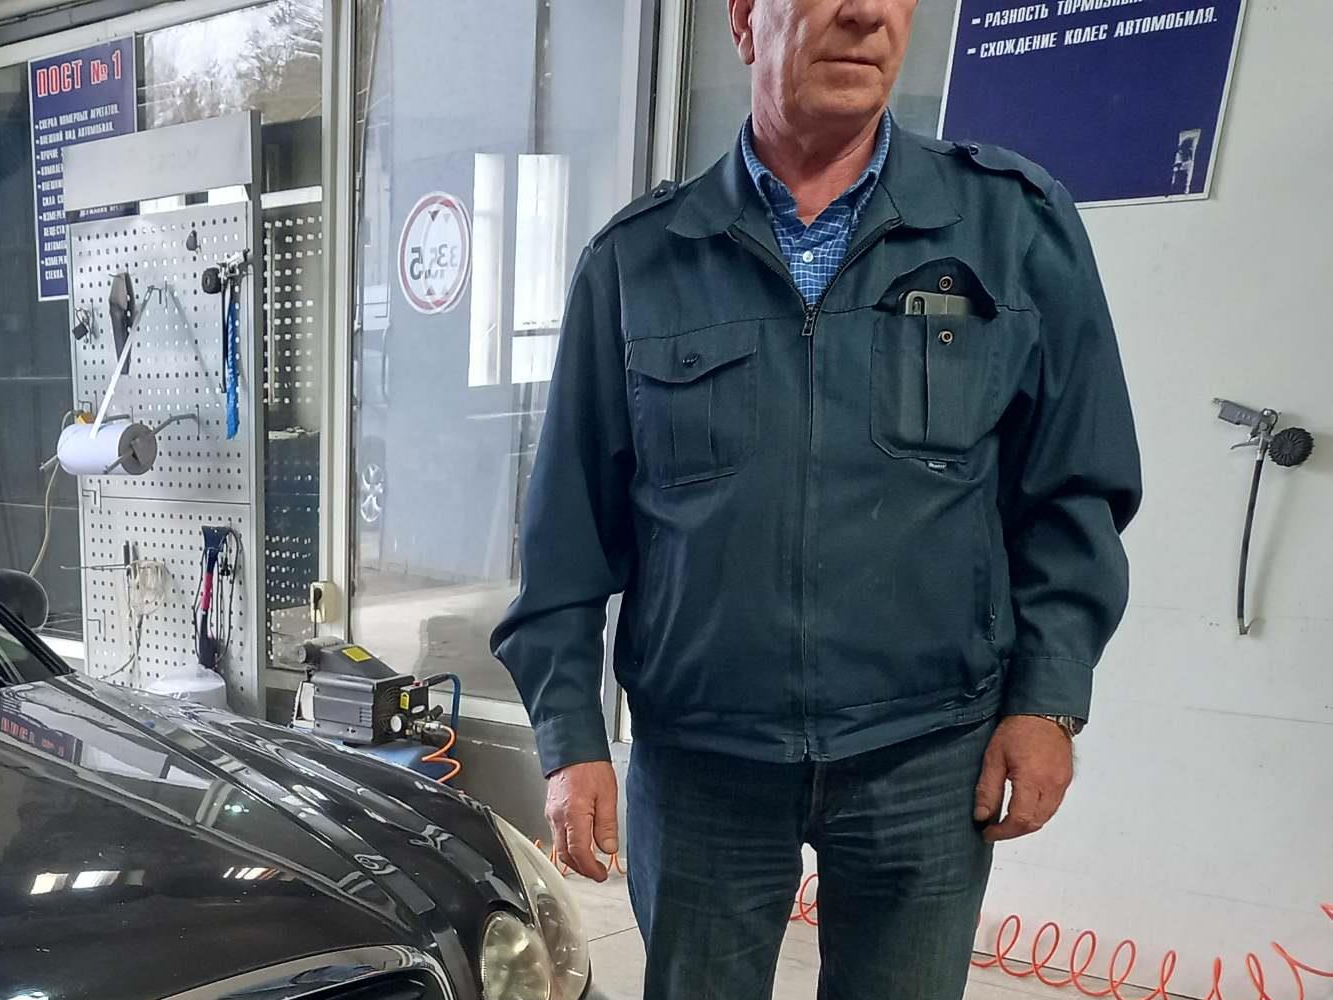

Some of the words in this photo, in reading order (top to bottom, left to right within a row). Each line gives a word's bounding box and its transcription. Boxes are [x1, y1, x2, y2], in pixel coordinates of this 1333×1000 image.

[980, 32, 1058, 58] СХОЖДЕНИЕ
[1064, 24, 1108, 46] КОЛЕС
[1114, 6, 1218, 38] АВТОМОБИЛЯ.
[984, 4, 1049, 28] РАЗНОСТЬ
[36, 59, 83, 98] ПОСТ
[111, 49, 122, 80] 1
